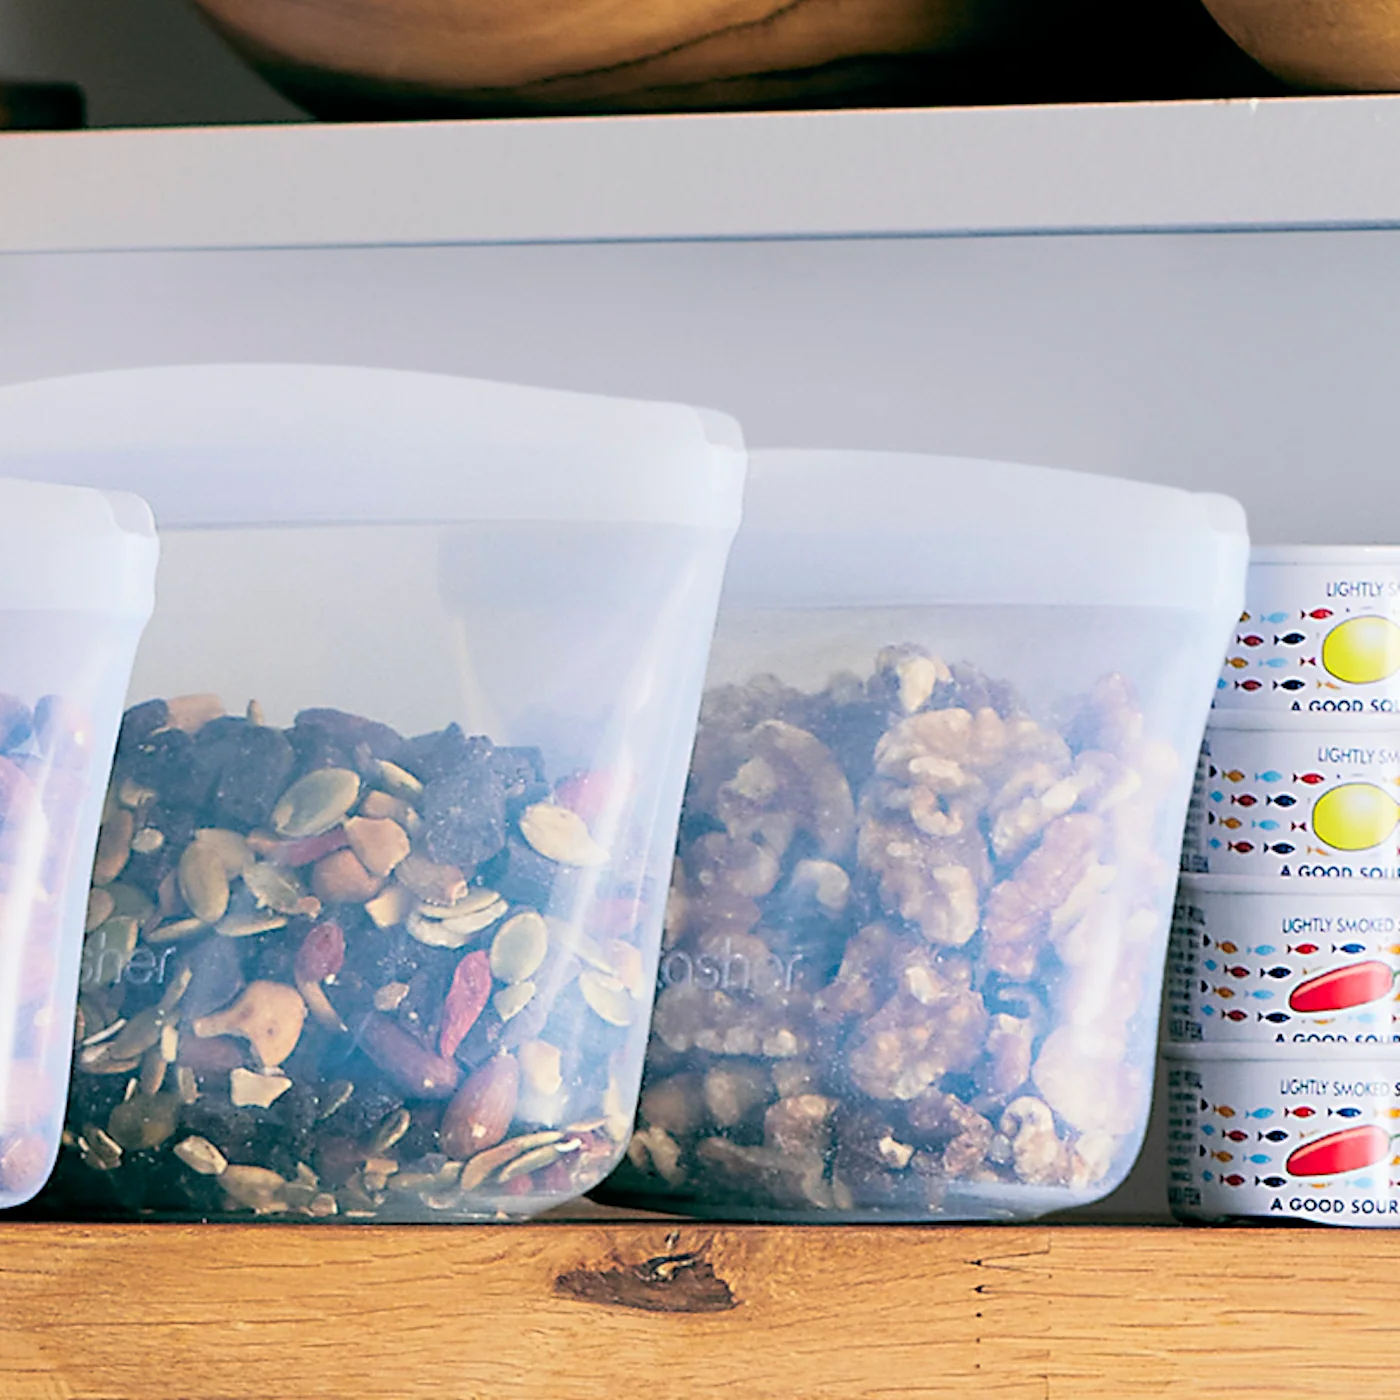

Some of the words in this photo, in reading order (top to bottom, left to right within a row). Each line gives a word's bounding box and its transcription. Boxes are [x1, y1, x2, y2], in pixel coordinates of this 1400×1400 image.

[1326, 581, 1383, 598] LIGHTLY
[1291, 700, 1302, 712] A
[1309, 699, 1364, 712] GOOD
[1318, 747, 1375, 765] LIGHTLY
[1280, 864, 1291, 877] A
[1298, 864, 1353, 878] GOOD
[1359, 866, 1400, 879] SOU
[1282, 917, 1333, 934] LIGHTLY
[1337, 917, 1395, 934] SMOKED
[1280, 1078, 1330, 1096] LIGHTLY
[1333, 1080, 1390, 1097] SMOKED
[1270, 1197, 1283, 1212] A
[1289, 1198, 1345, 1214] GOOD
[1351, 1199, 1399, 1215] SOUR
